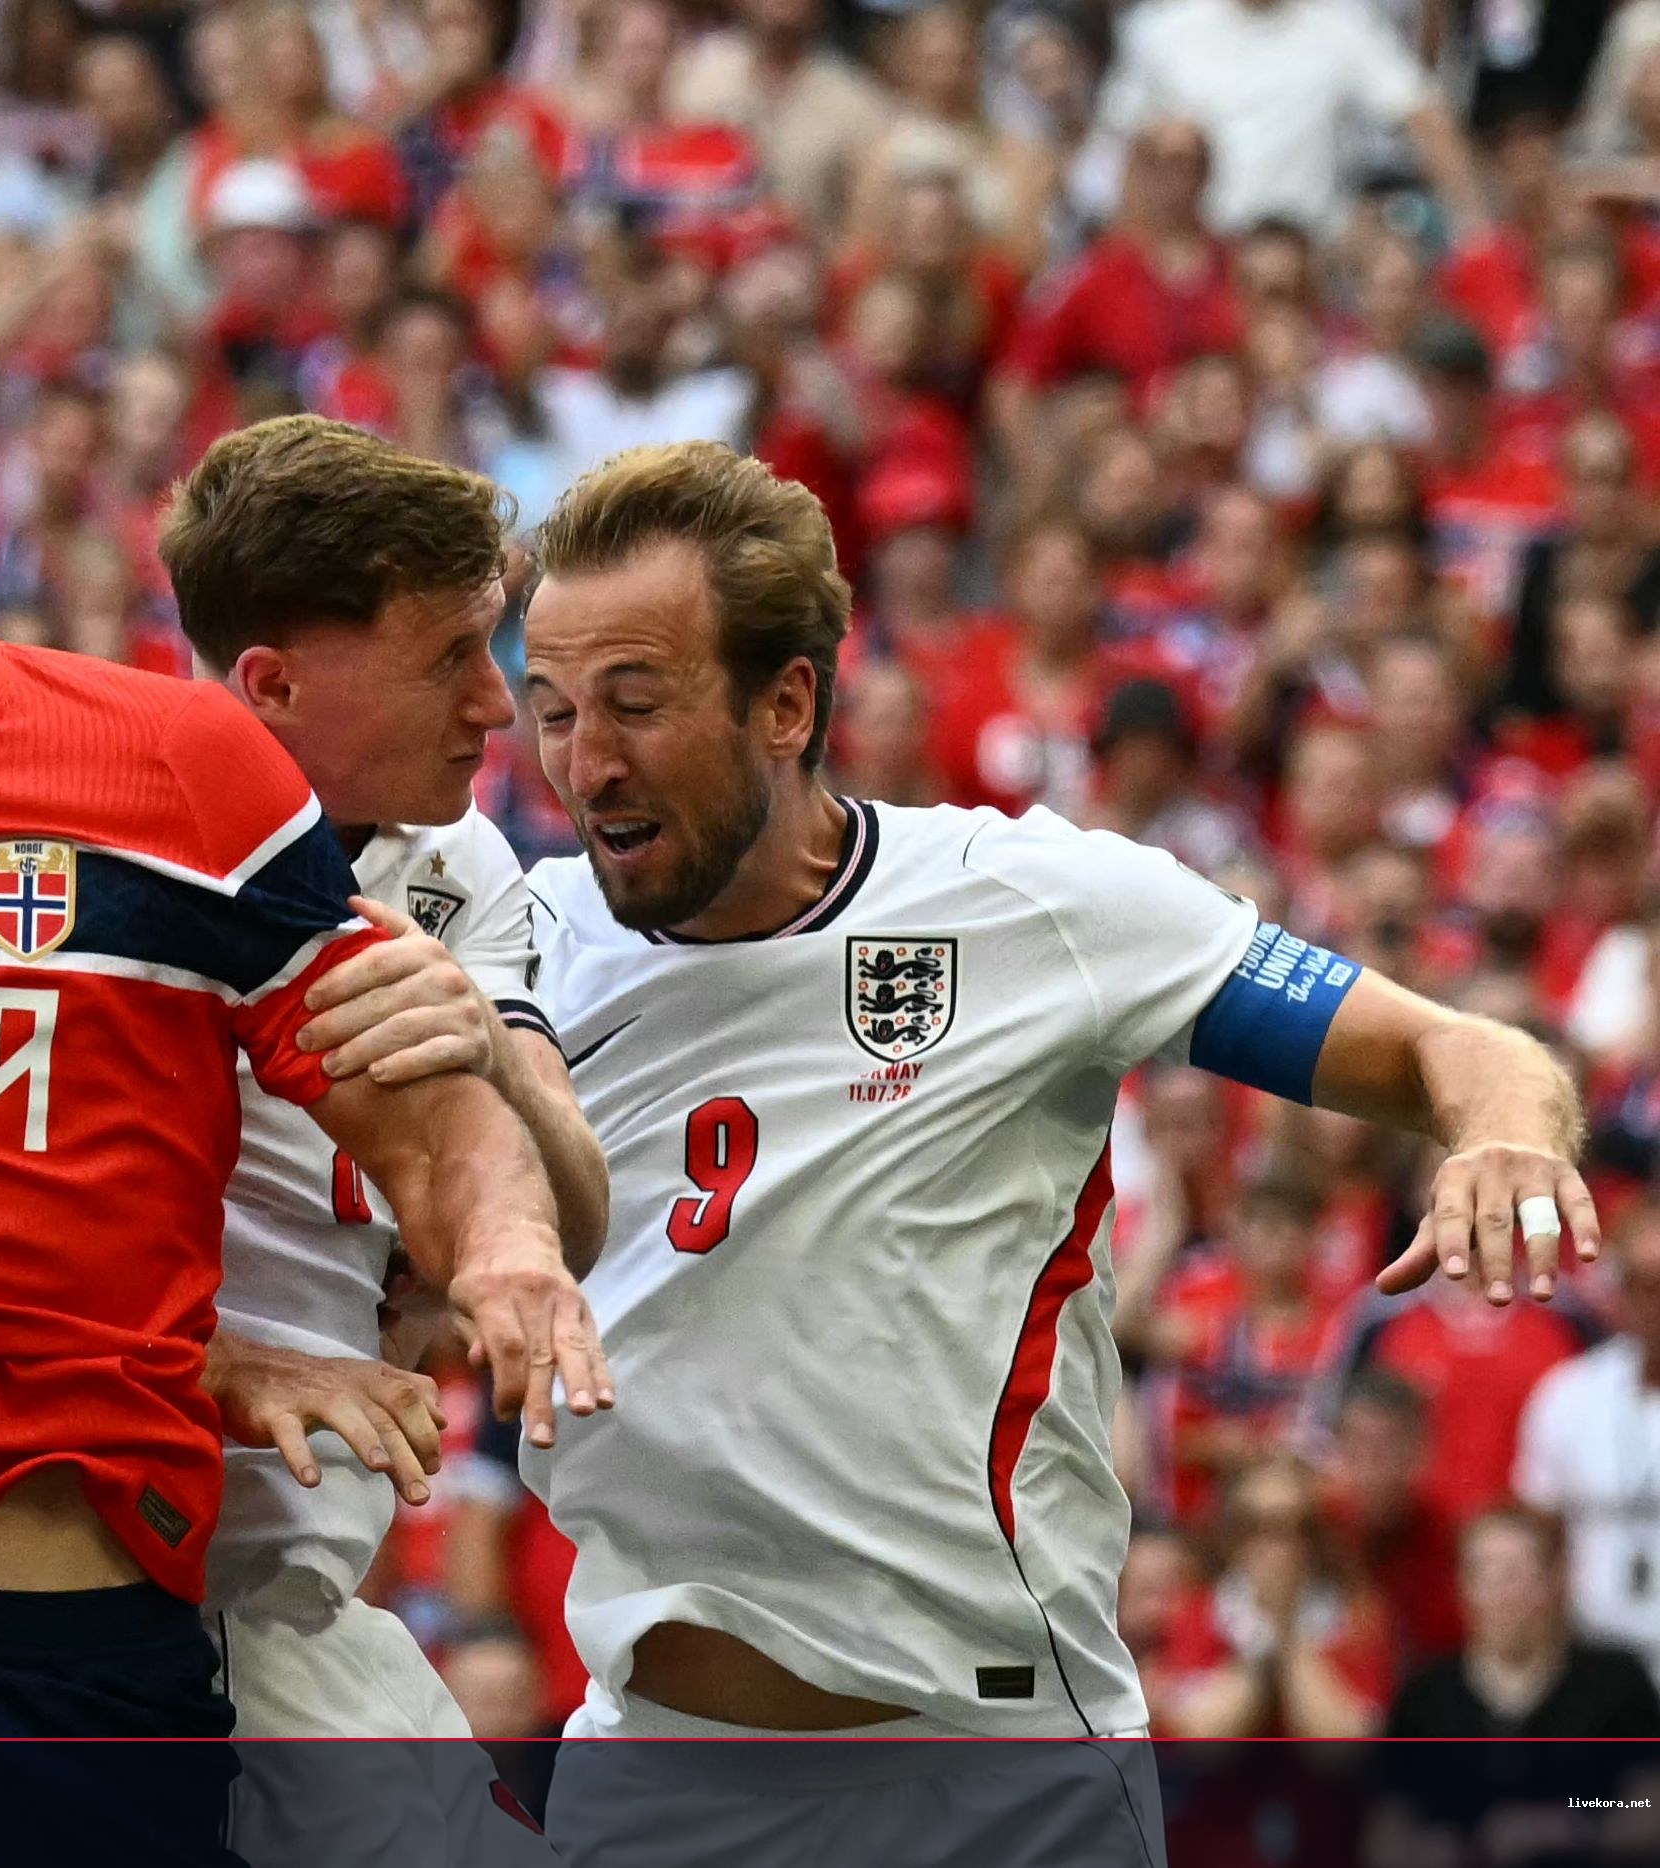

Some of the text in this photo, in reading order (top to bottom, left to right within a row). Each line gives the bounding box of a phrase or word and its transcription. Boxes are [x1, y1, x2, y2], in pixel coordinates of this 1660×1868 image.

[14, 843, 43, 855] NORGE
[1286, 973, 1316, 1003] the
[665, 1096, 759, 1255] 9
